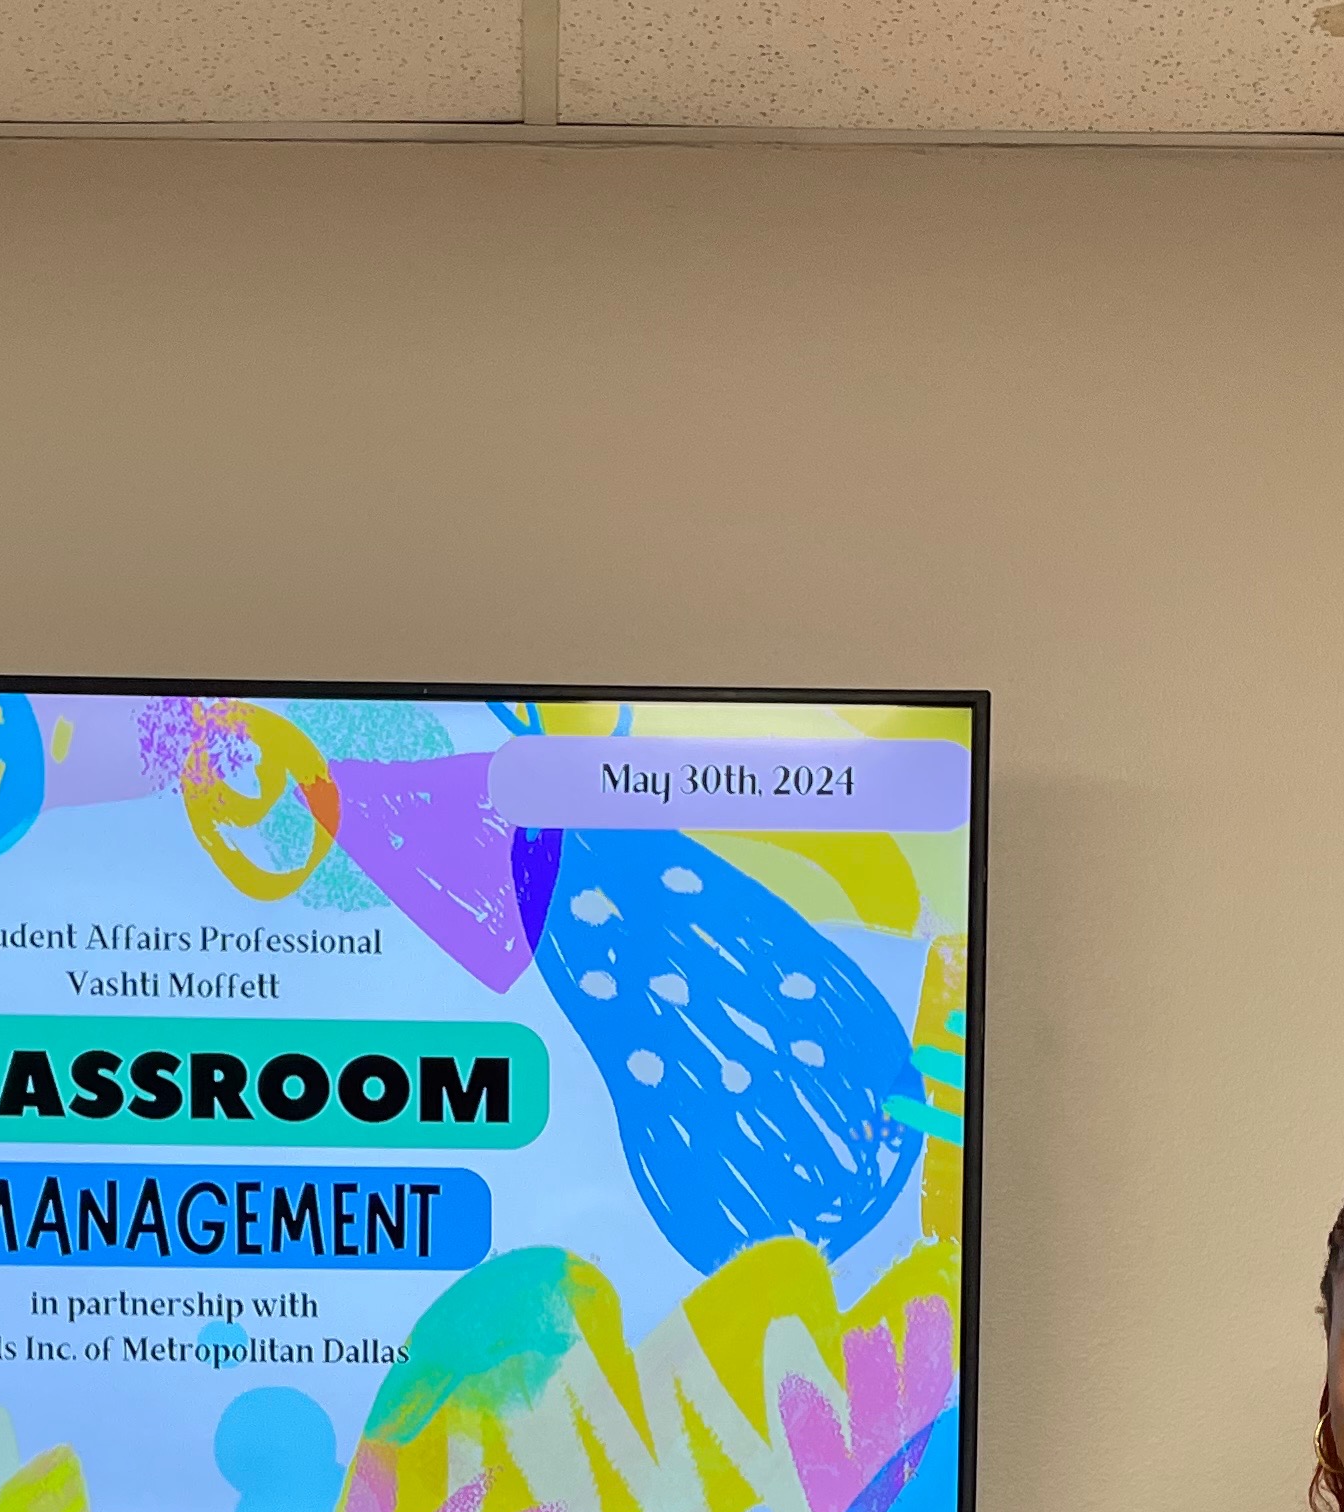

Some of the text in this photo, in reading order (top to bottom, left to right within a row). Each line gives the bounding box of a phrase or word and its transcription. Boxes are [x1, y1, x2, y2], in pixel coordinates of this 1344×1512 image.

[602, 764, 855, 803] May 30th, 2024
[86, 923, 191, 953] Affairs
[199, 926, 383, 955] Professional
[66, 970, 280, 1000] Vashti Moffett
[30, 1291, 319, 1323] in partnership with
[25, 1335, 77, 1361] Inc.
[84, 1335, 115, 1361] of
[122, 1337, 314, 1368] Metropolitan
[322, 1337, 409, 1364] Dallas
